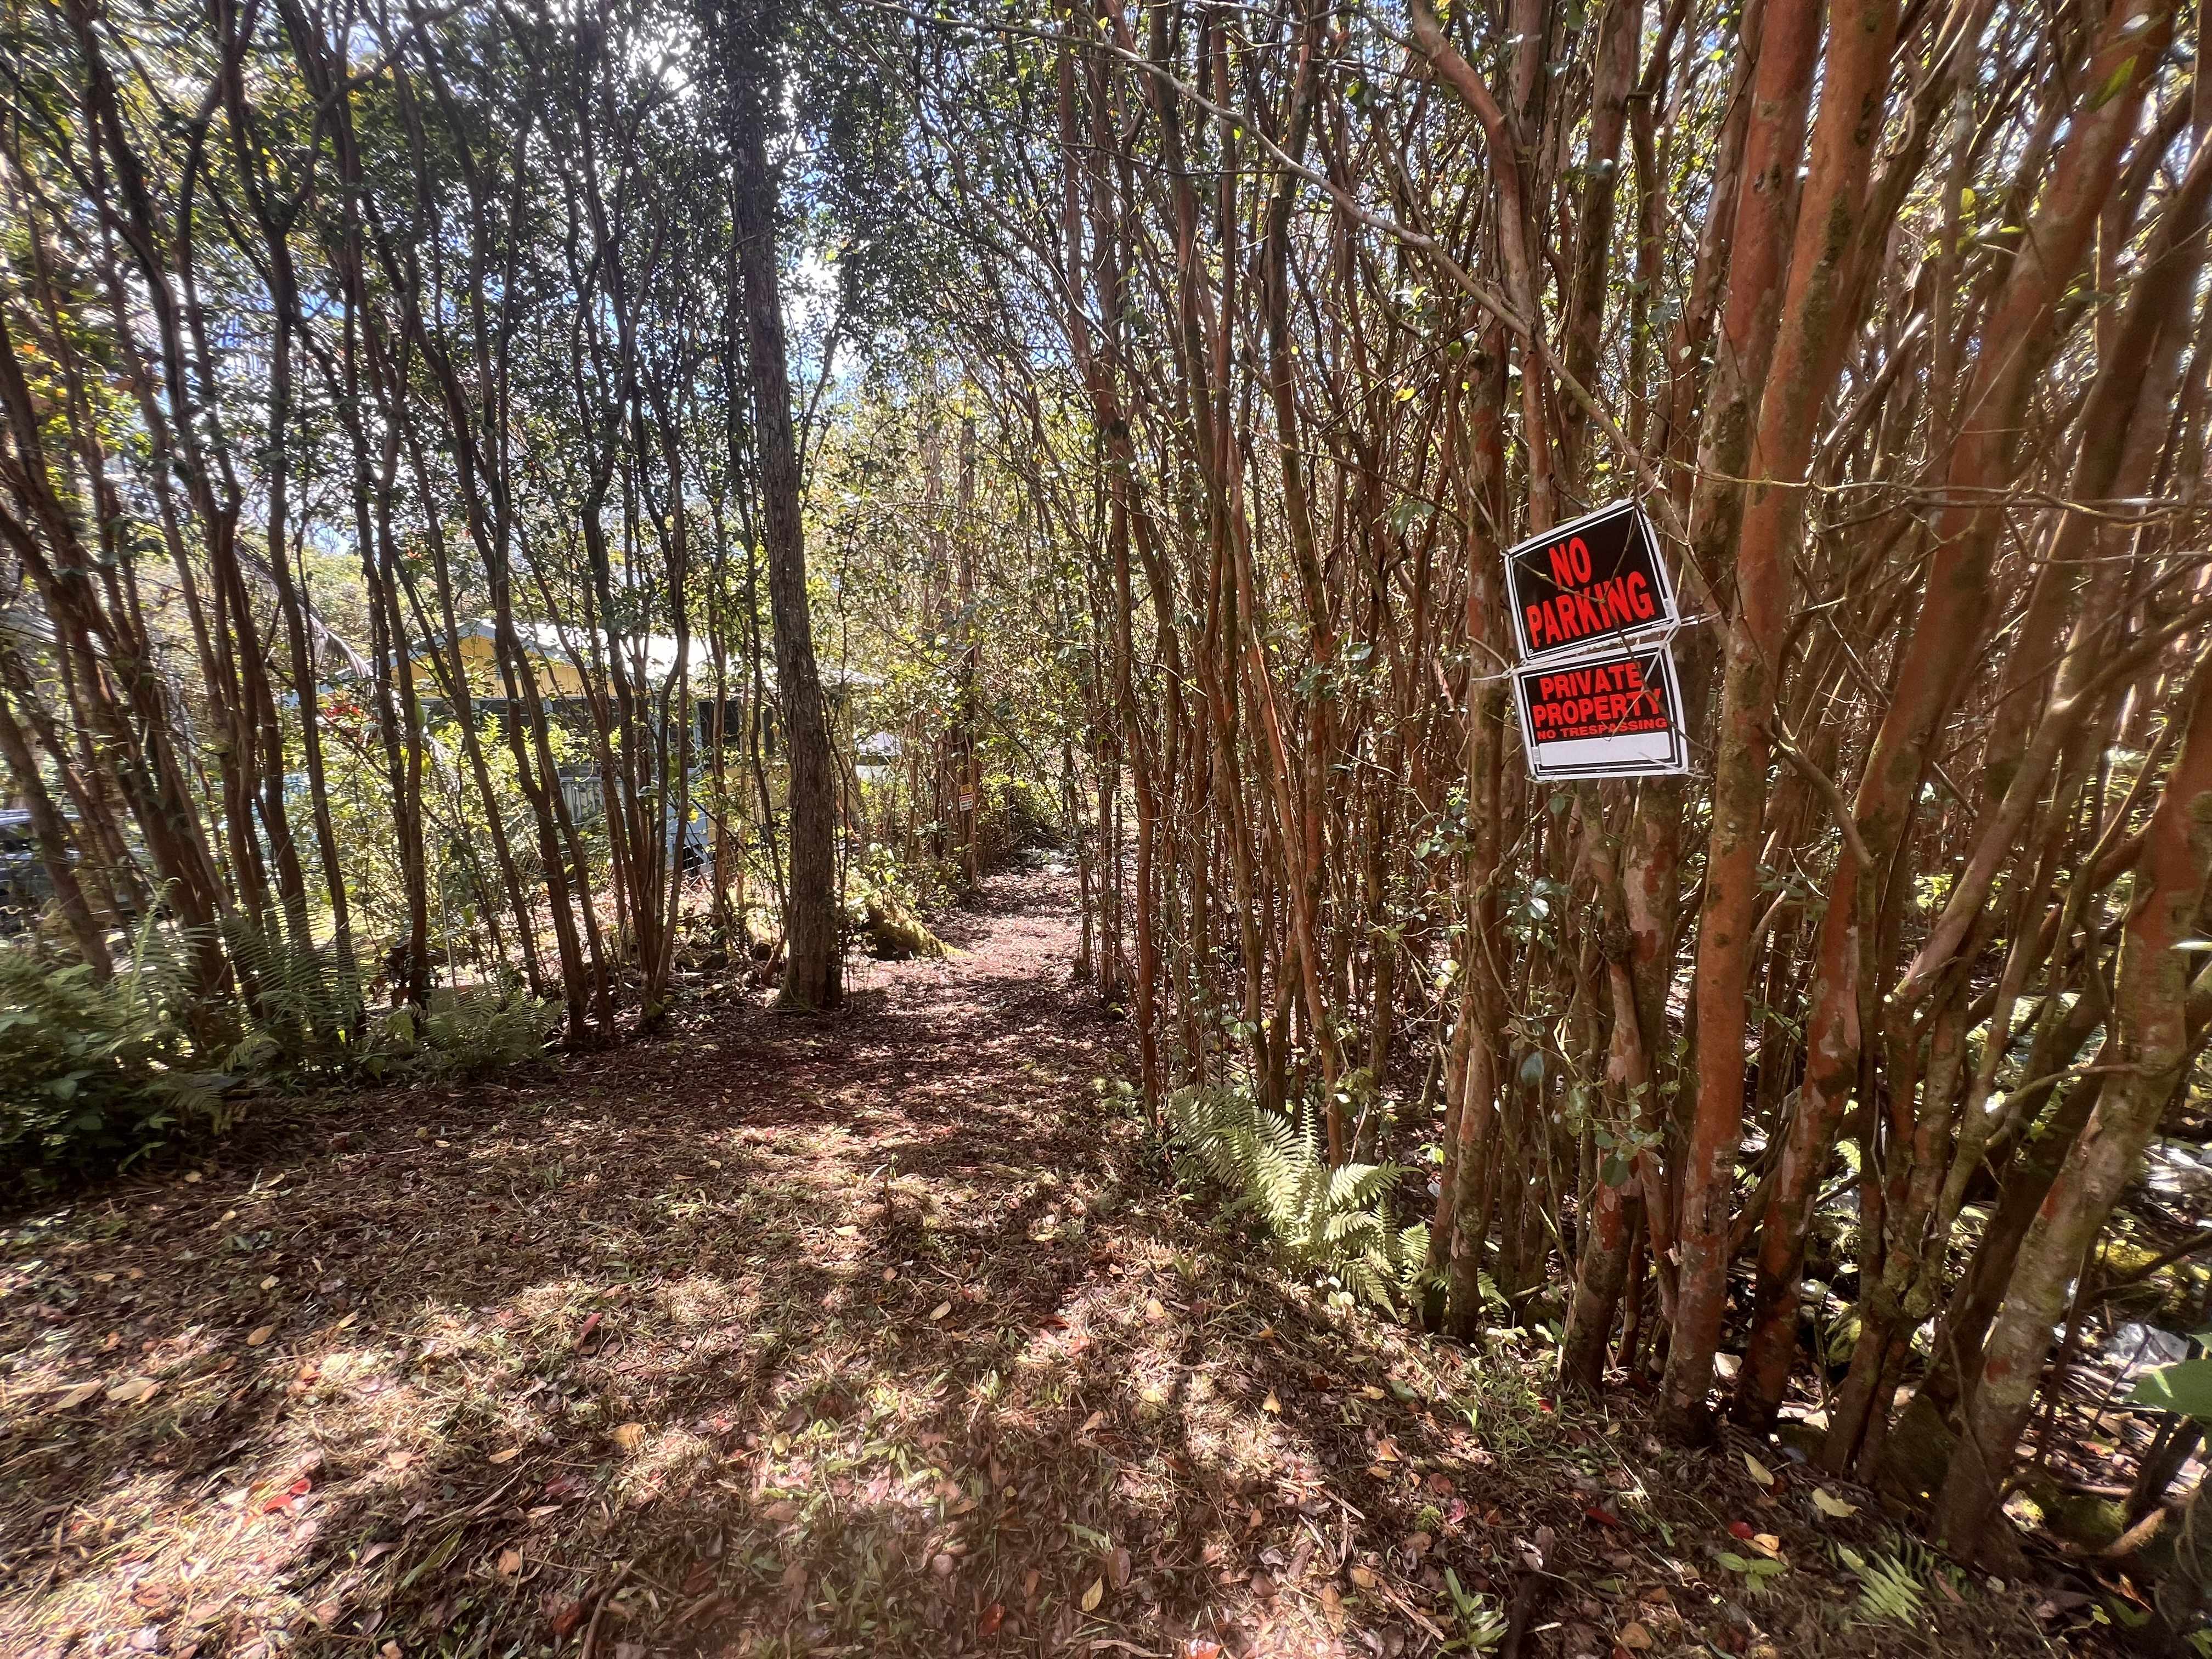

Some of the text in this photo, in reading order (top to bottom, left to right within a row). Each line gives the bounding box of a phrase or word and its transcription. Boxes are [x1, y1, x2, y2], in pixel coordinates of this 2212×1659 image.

[1549, 537, 1591, 590] NO
[1526, 571, 1655, 647] PARKING
[1539, 661, 1644, 701] PRIVATE
[1532, 688, 1661, 727] PROPERTY
[1537, 718, 1667, 740] NO TRESPASSING
